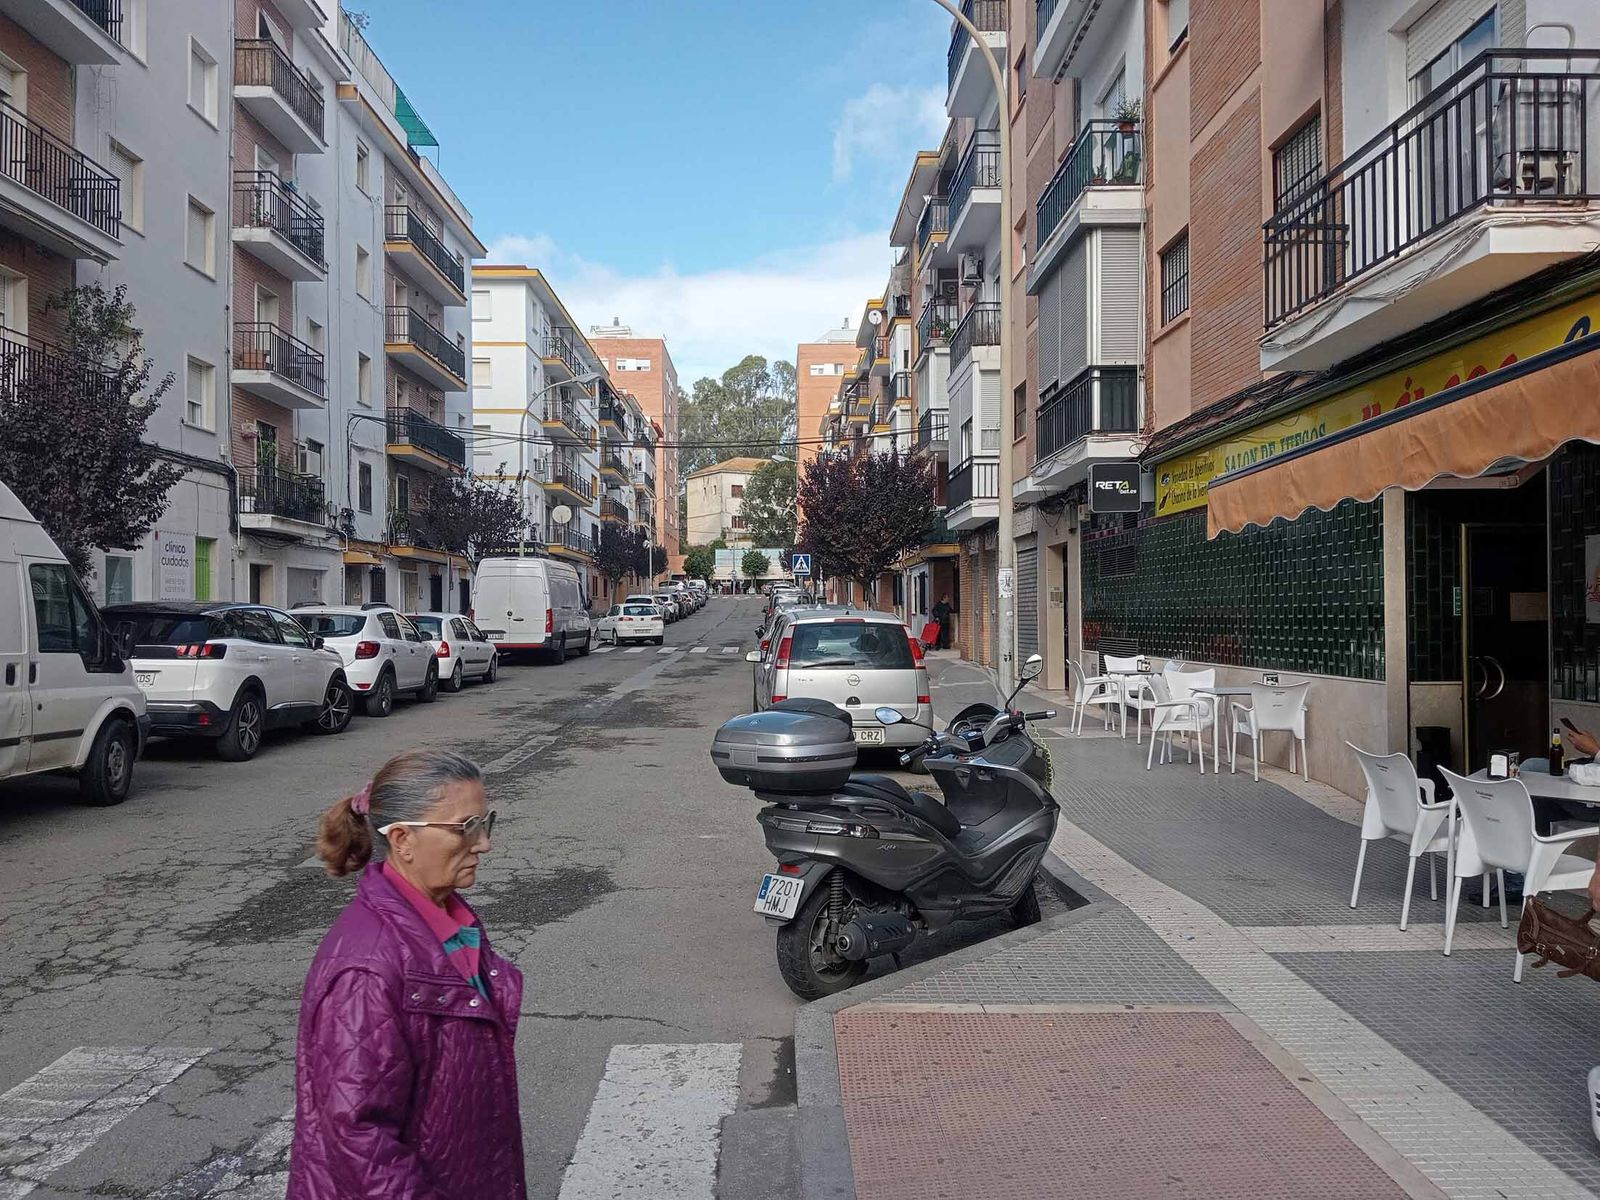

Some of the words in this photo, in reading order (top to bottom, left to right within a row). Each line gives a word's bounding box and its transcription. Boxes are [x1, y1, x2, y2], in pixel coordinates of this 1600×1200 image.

[1095, 480, 1130, 491] RETA
[860, 731, 880, 741] CRZ
[769, 878, 800, 898] 7201
[763, 895, 789, 913] HMJ
